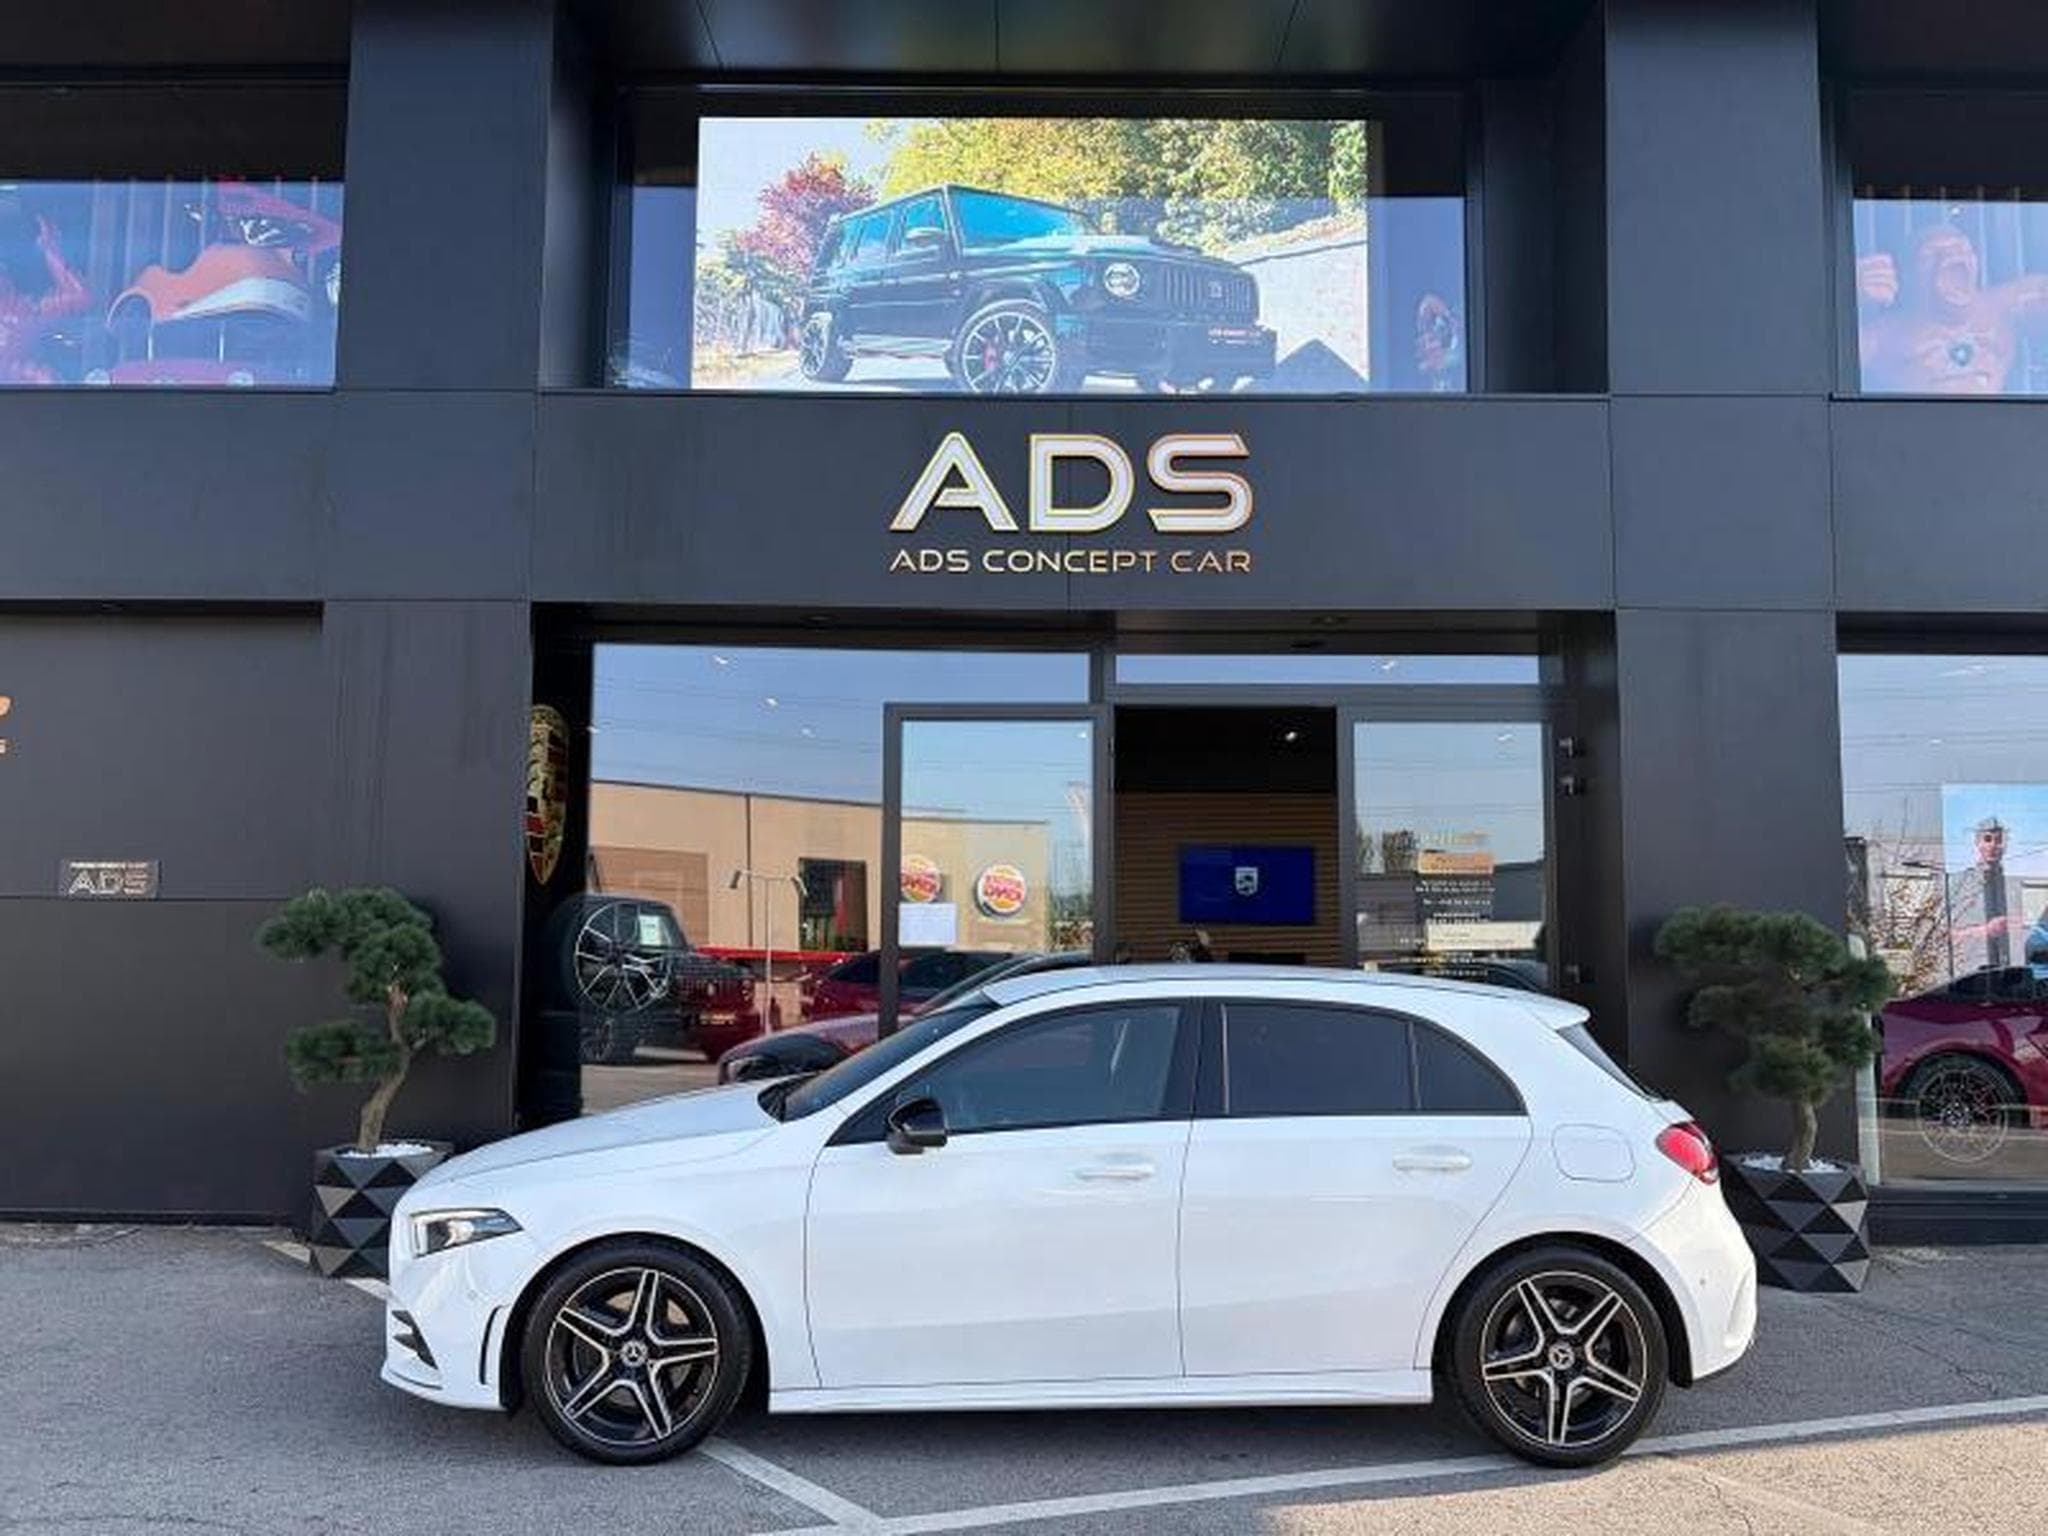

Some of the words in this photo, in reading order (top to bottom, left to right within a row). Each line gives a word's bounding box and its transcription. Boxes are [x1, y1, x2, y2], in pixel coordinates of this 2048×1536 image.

[889, 431, 1254, 533] ADS
[889, 549, 971, 573] ADS
[982, 549, 1158, 573] CONCEPT
[1170, 549, 1252, 573] CAR
